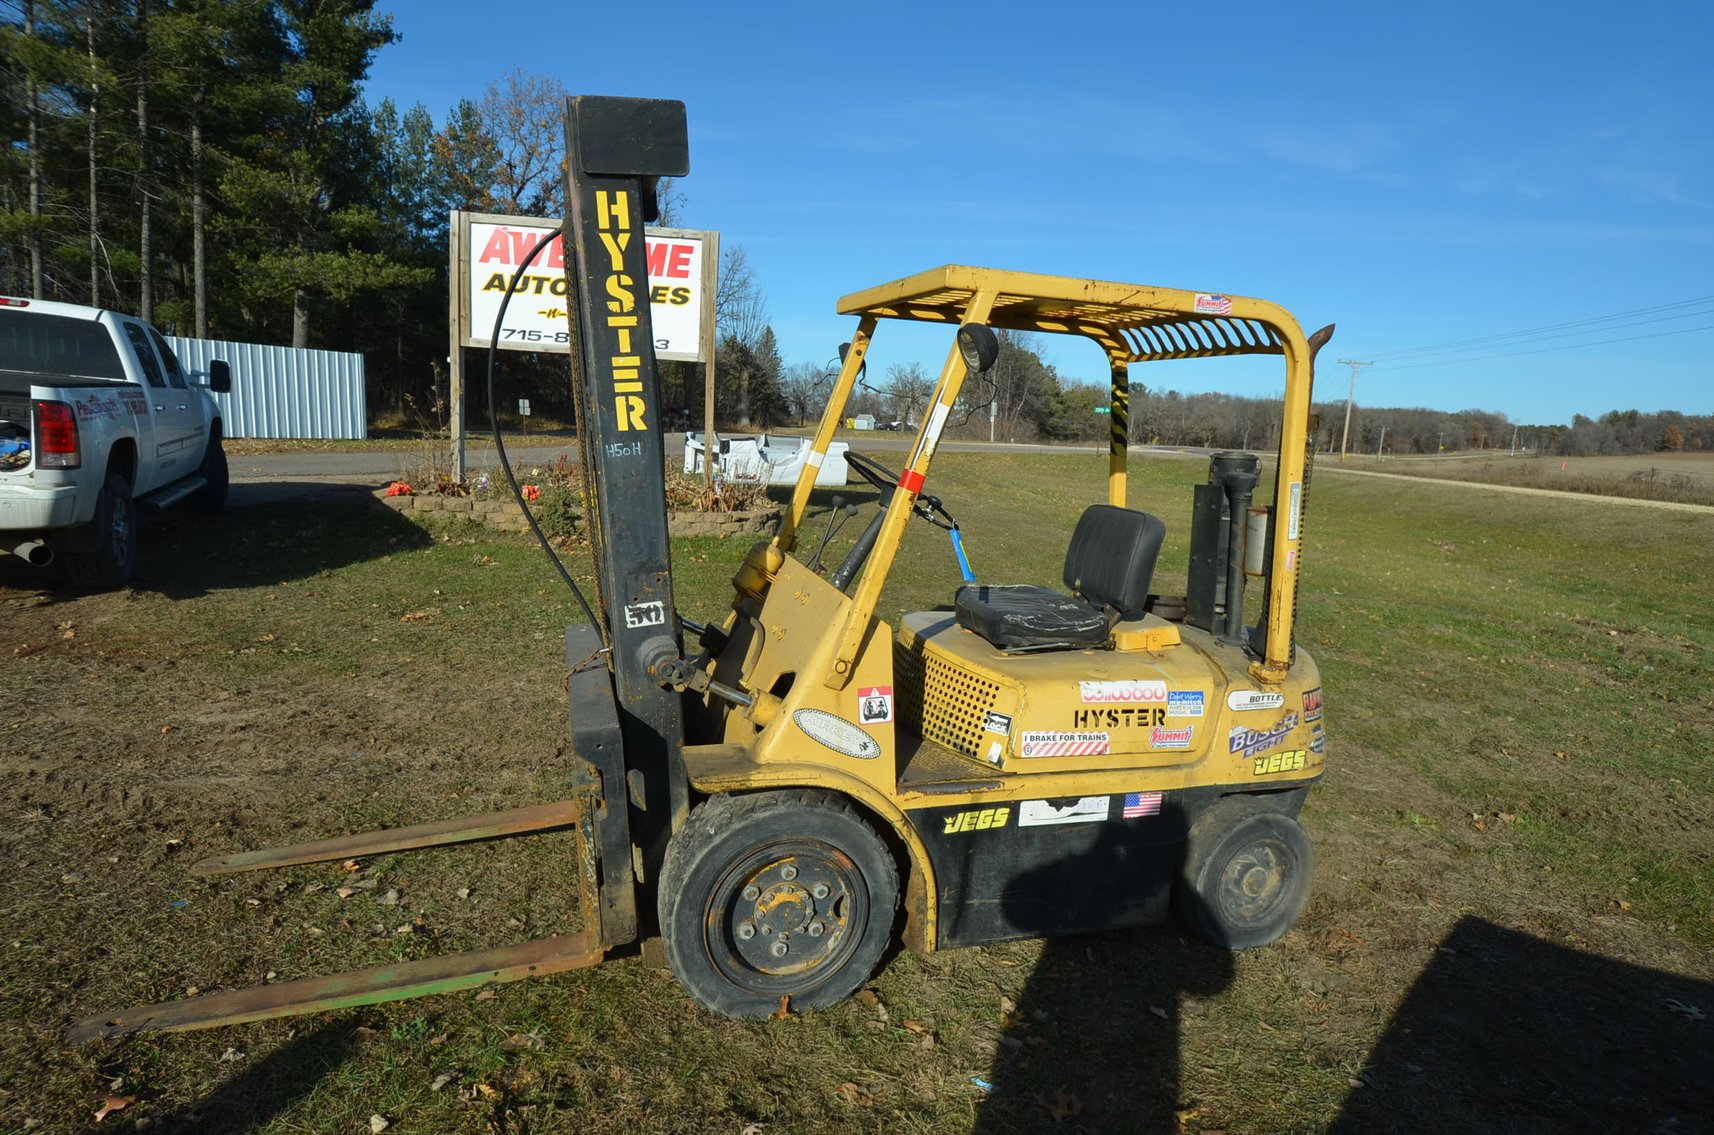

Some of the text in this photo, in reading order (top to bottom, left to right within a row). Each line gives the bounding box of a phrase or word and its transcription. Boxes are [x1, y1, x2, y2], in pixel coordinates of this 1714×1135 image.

[482, 273, 568, 295] AUTO
[596, 191, 648, 432] HYSTER
[1249, 694, 1282, 703] BOTTLE
[1074, 708, 1166, 728] HYSTER
[1078, 734, 1107, 742] TRAINS
[1254, 751, 1306, 775] JEGS
[943, 808, 1010, 834] JEGS
